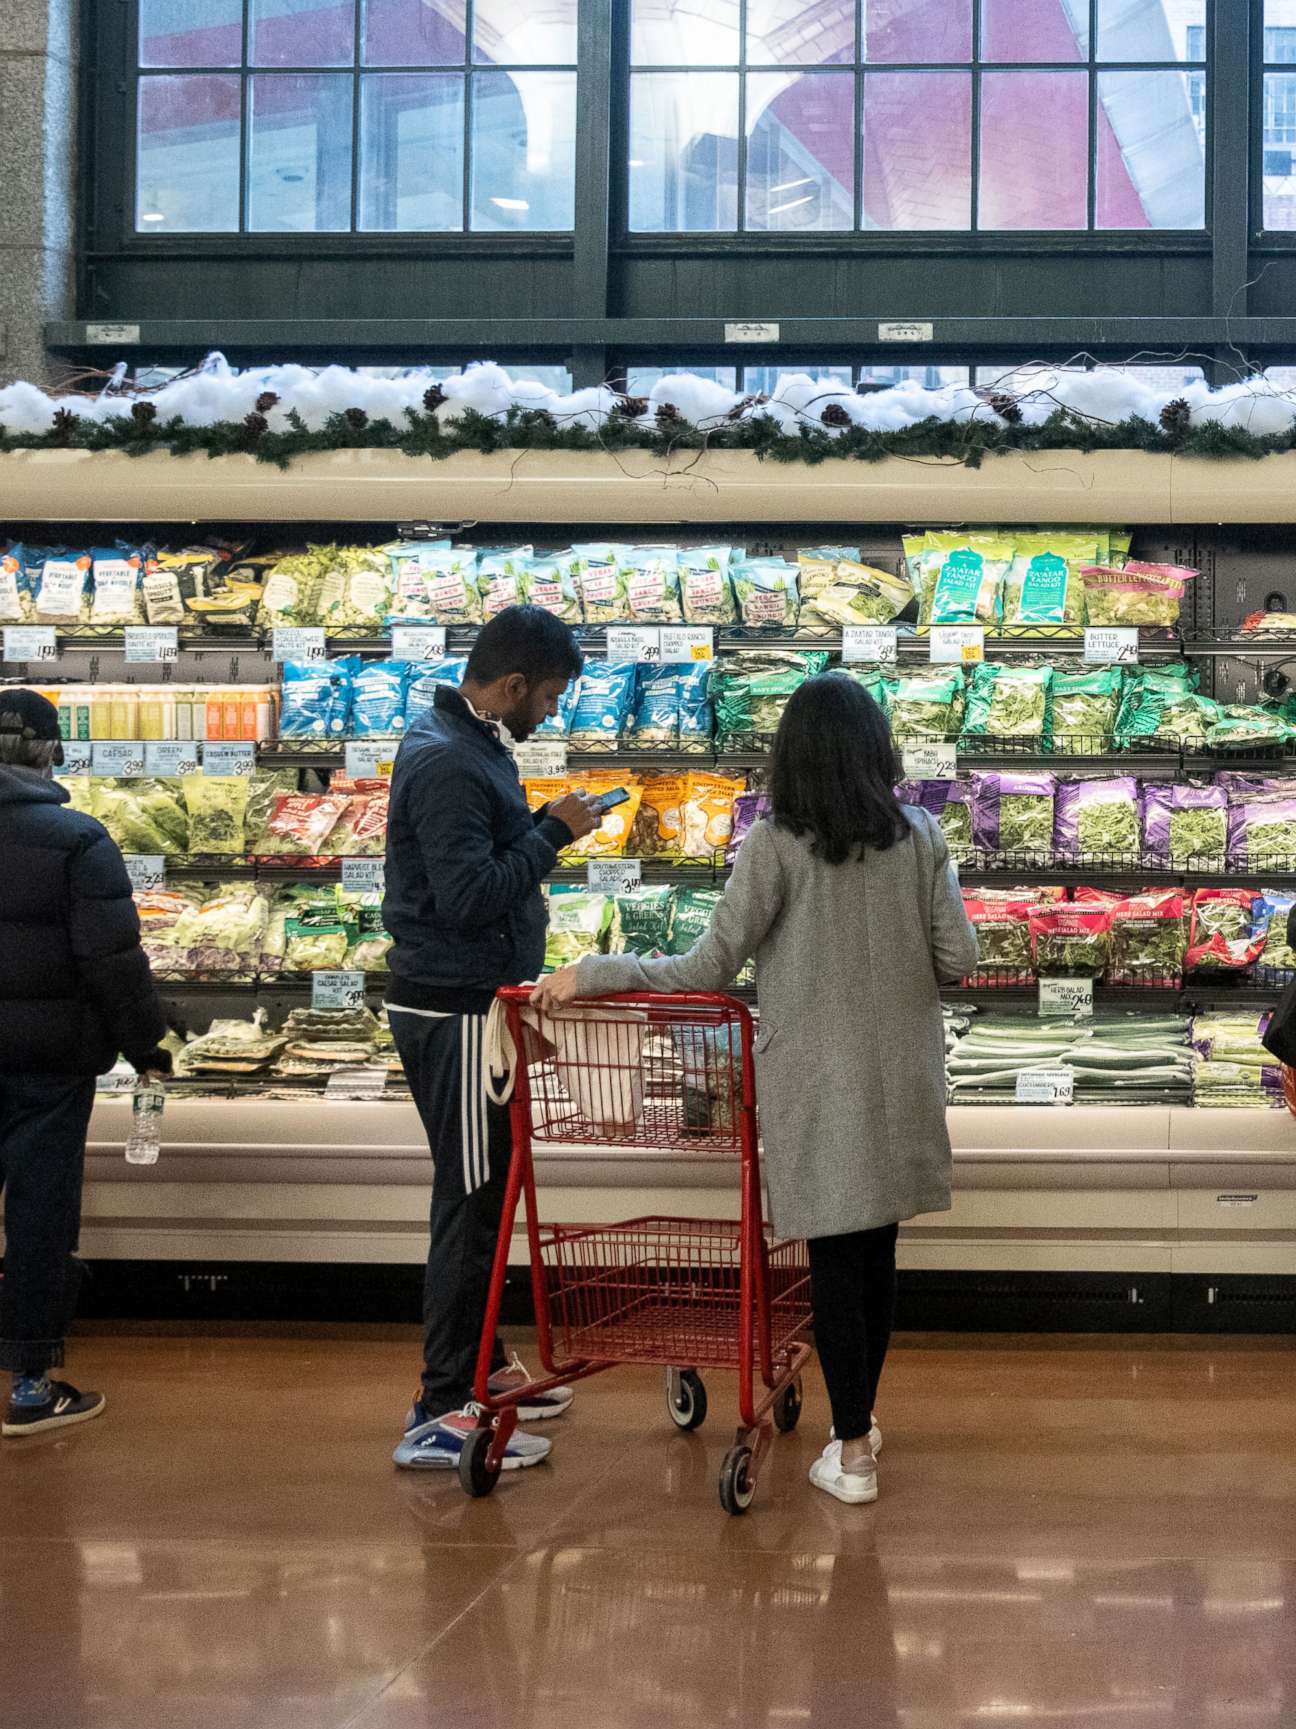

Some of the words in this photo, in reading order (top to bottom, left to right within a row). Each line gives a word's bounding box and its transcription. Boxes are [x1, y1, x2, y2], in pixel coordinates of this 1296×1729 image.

[946, 573, 976, 583] TANGO
[1098, 574, 1129, 583] BUTTER
[102, 749, 133, 758] CAESAR
[157, 746, 183, 754] GREEN
[230, 749, 252, 758] BUTTER
[343, 862, 369, 871] HARVEST
[343, 871, 363, 879] SALAD
[365, 871, 375, 879] KIT
[624, 902, 665, 911] VEGGIES
[684, 905, 713, 916] VEGGI
[634, 911, 666, 921] GREENS
[1115, 910, 1130, 918] HERB
[1132, 910, 1149, 918] SALAD
